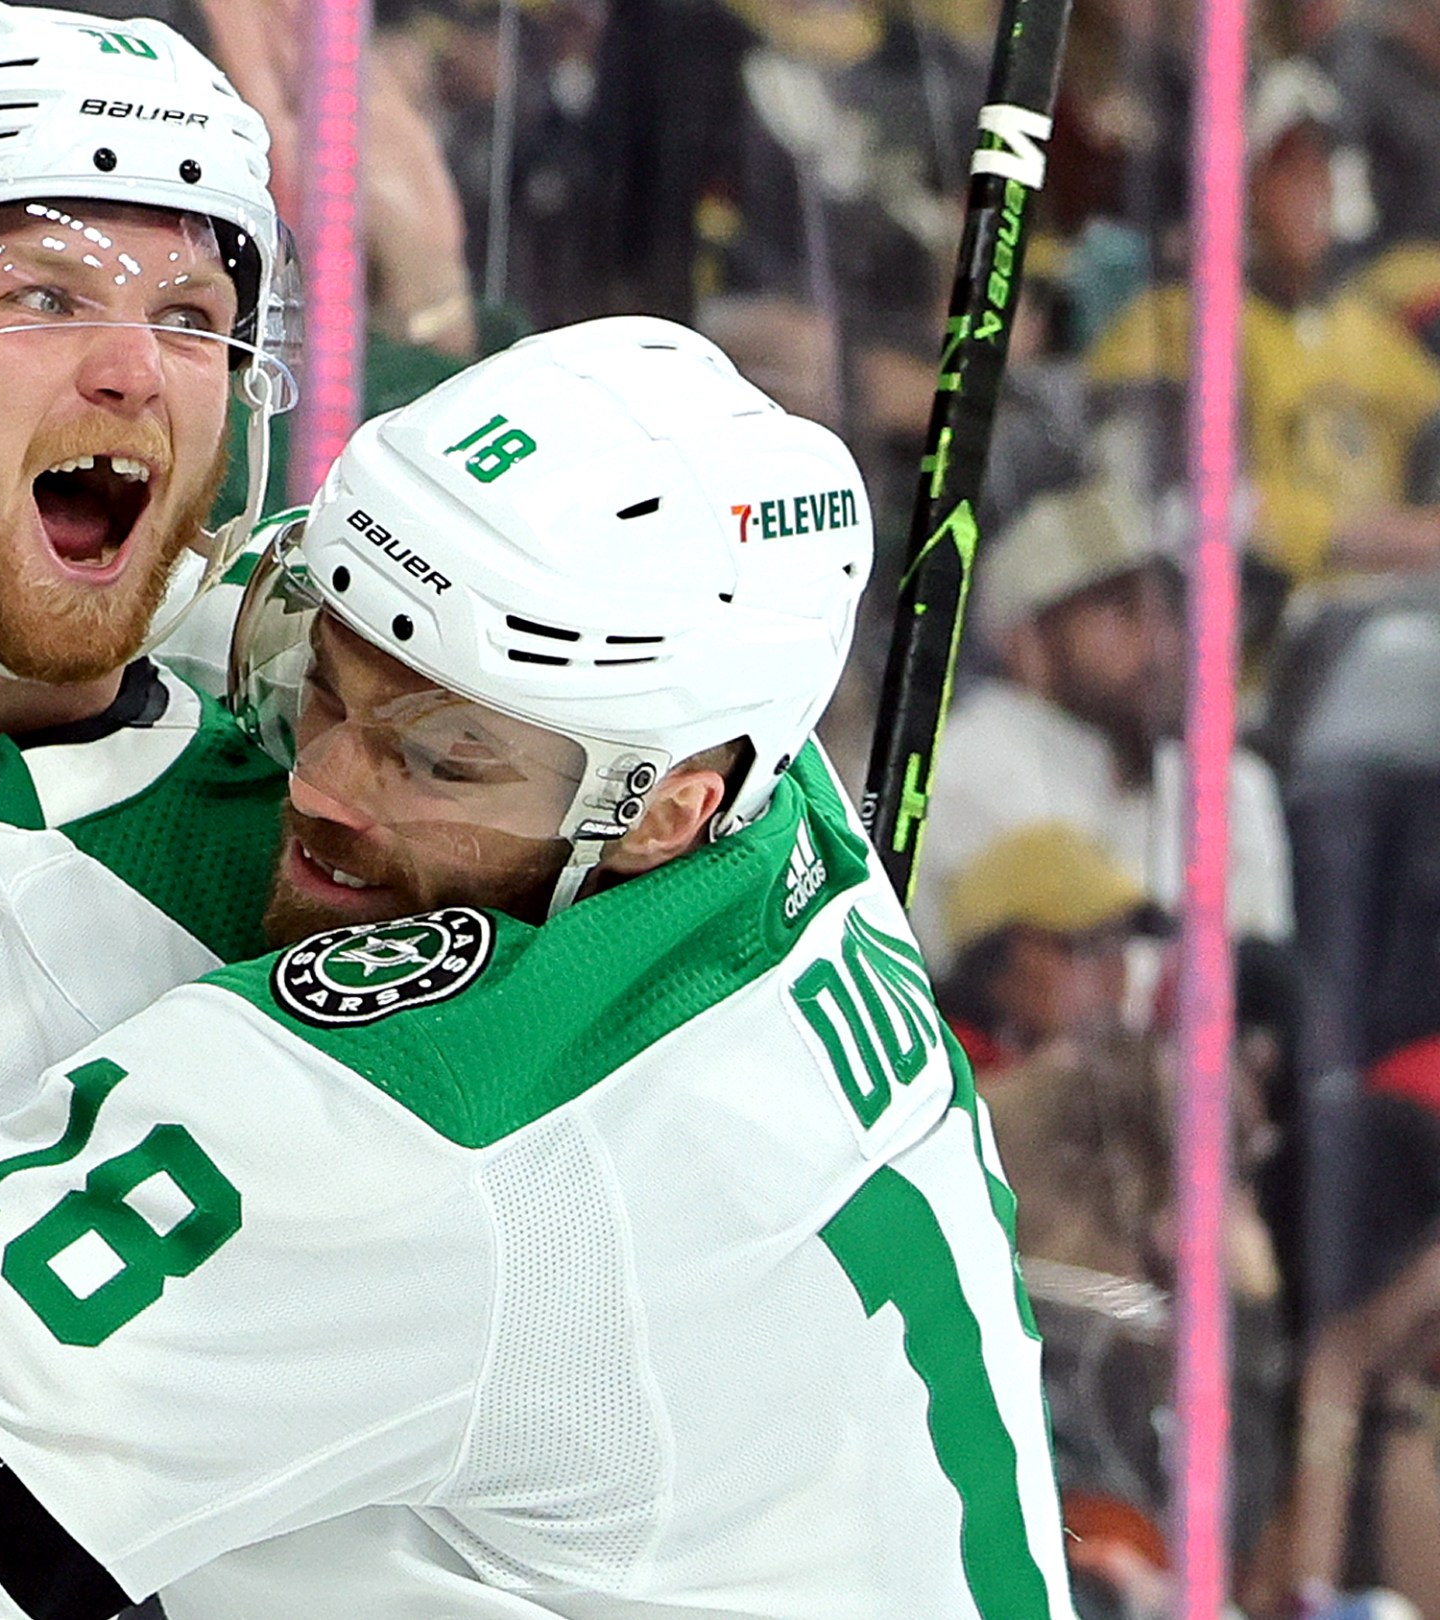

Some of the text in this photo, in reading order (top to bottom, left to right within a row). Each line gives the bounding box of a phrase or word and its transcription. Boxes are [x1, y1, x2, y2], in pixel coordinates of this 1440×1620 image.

[79, 99, 209, 129] BAUER
[442, 413, 537, 484] 18
[730, 488, 857, 543] 7-ELEVEN
[346, 509, 452, 596] BAUER
[785, 859, 827, 919] adidas
[291, 951, 401, 1012] STARS
